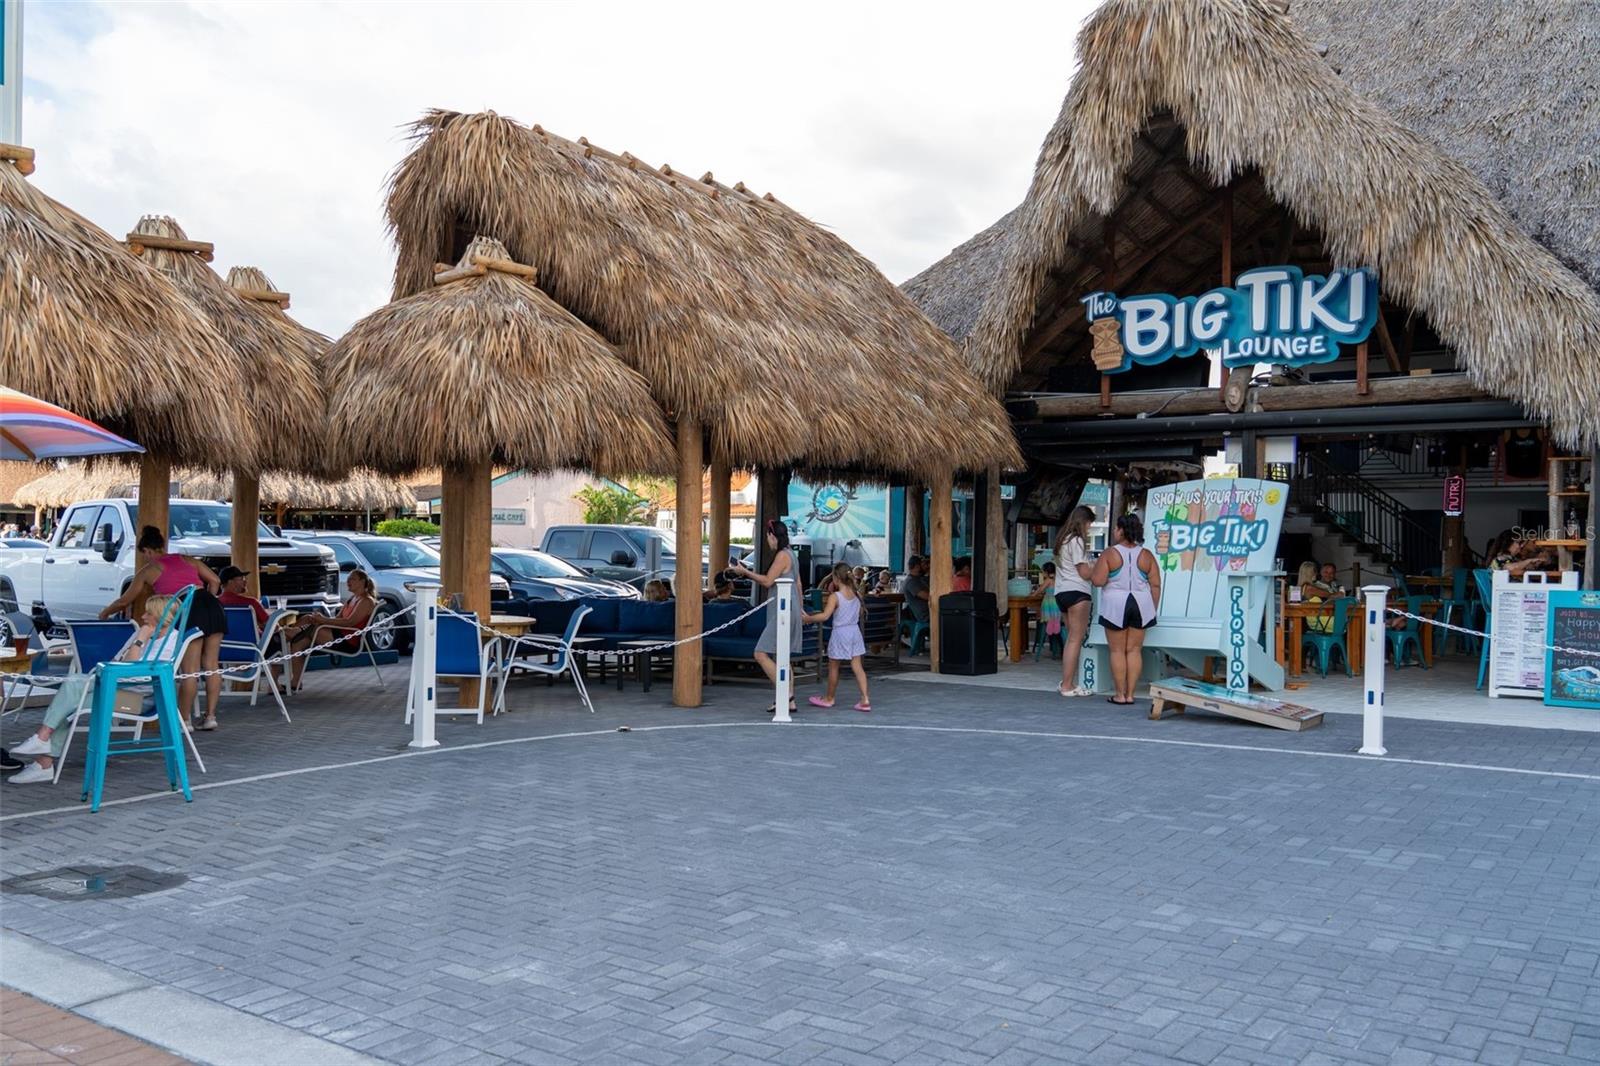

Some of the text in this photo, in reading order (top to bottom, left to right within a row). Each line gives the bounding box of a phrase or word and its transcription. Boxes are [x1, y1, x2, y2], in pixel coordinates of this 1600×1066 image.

[1081, 292, 1116, 322] The
[1120, 270, 1366, 357] BIG TIKI
[1223, 335, 1326, 360] LOUNGE
[1152, 489, 1186, 508] SHOW
[1187, 491, 1201, 504] US
[1203, 489, 1232, 507] YOUR
[1170, 518, 1265, 550] BIG TIKI
[1210, 544, 1248, 555] LOUNGE
[1231, 586, 1244, 689] FLORIDA
[1083, 658, 1094, 689] KEY
